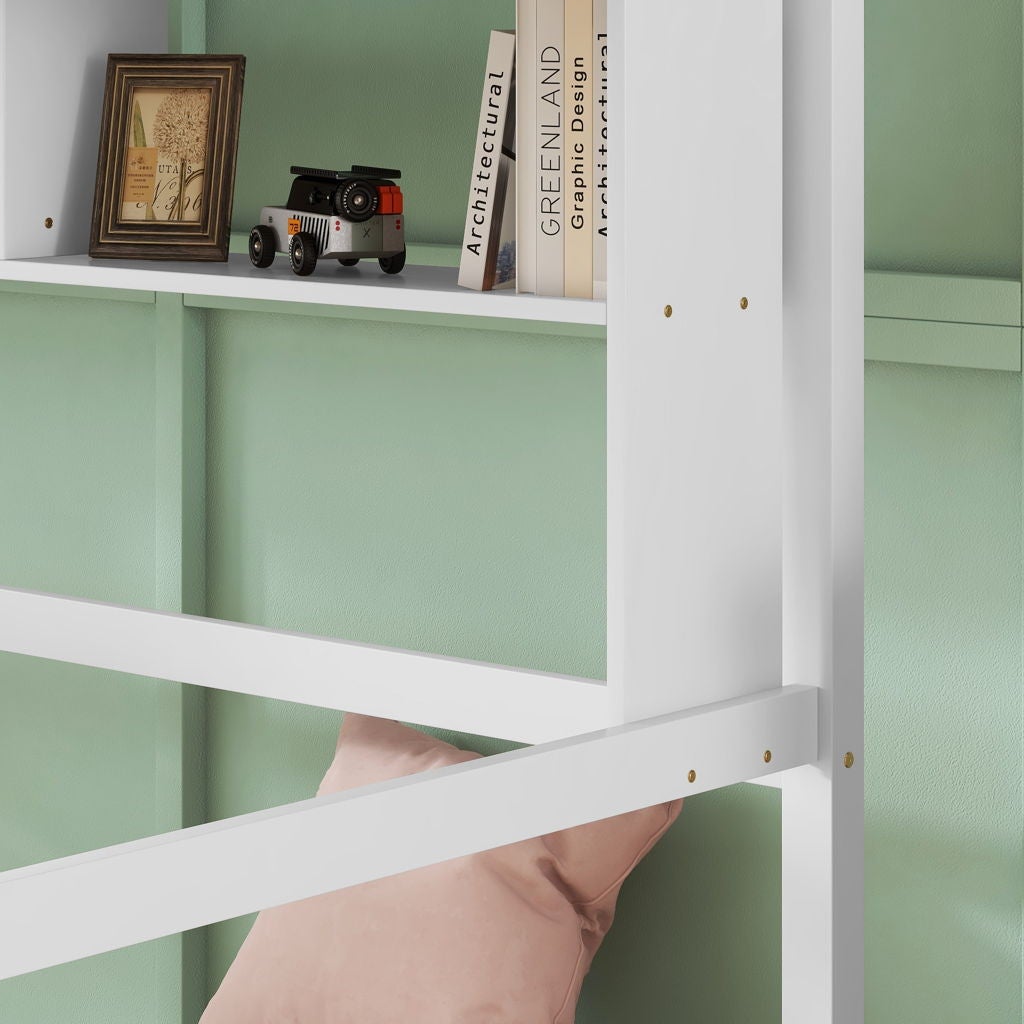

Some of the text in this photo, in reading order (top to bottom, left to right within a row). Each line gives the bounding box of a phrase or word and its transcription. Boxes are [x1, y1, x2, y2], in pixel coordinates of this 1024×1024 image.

[289, 222, 300, 233] 72
[466, 71, 504, 256] Architectural
[541, 46, 560, 236] GREENLAND
[570, 56, 586, 230] Graphic Design
